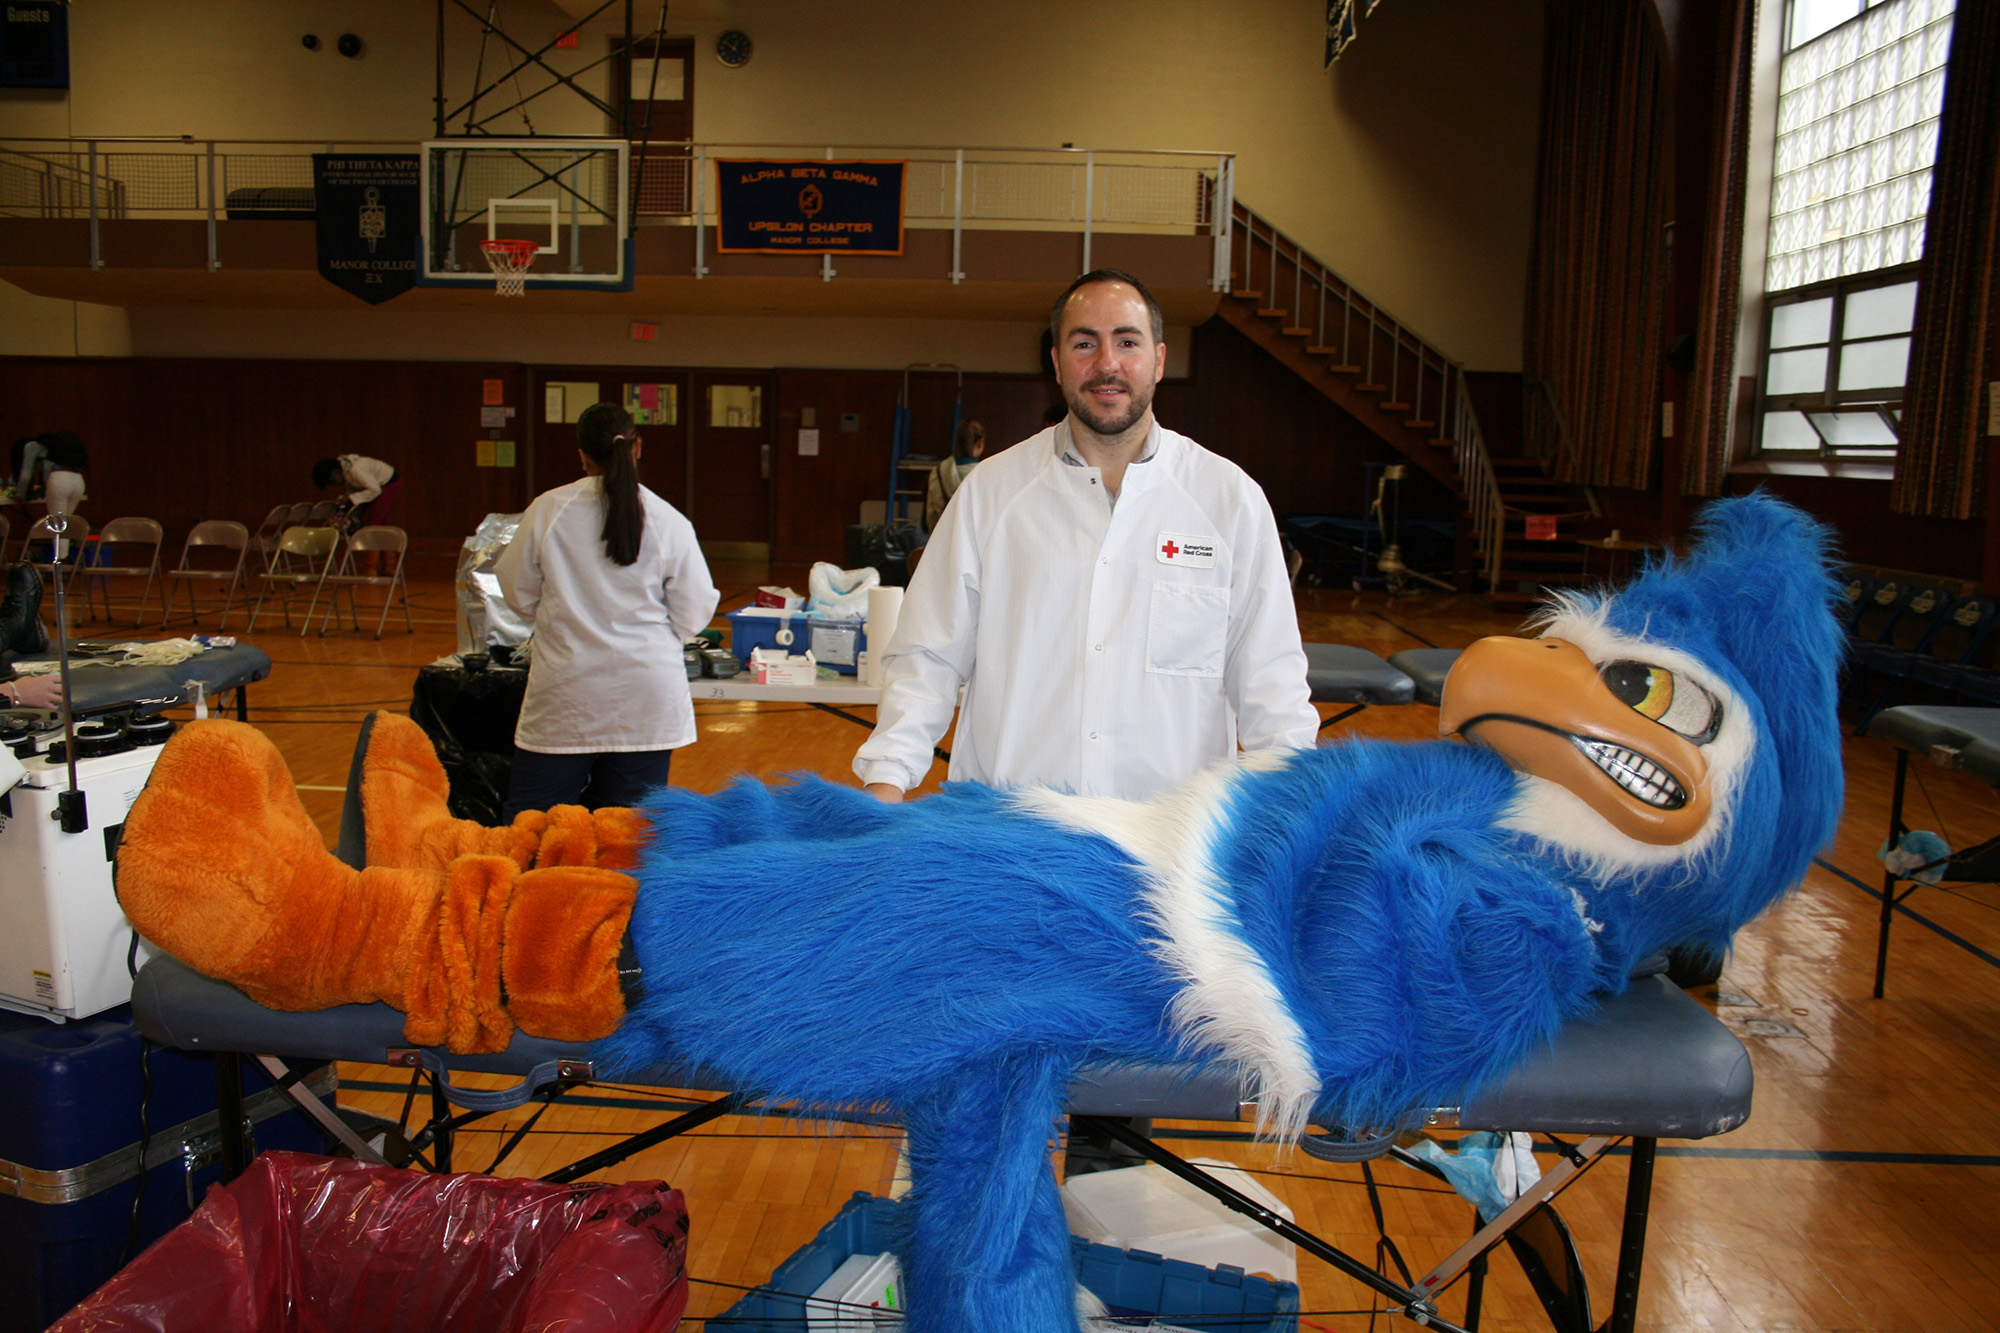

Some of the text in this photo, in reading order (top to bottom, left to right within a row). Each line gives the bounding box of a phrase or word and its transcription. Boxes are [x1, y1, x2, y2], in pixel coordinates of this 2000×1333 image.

[7, 6, 50, 23] Guests
[327, 160, 420, 170] PHI THETA KAPPA
[741, 168, 878, 187] ALPHA BETA GAMMA
[748, 221, 873, 233] UPSILON CHAPTER
[770, 236, 850, 244] MANOR COLLEGE
[330, 260, 369, 270] MANOR
